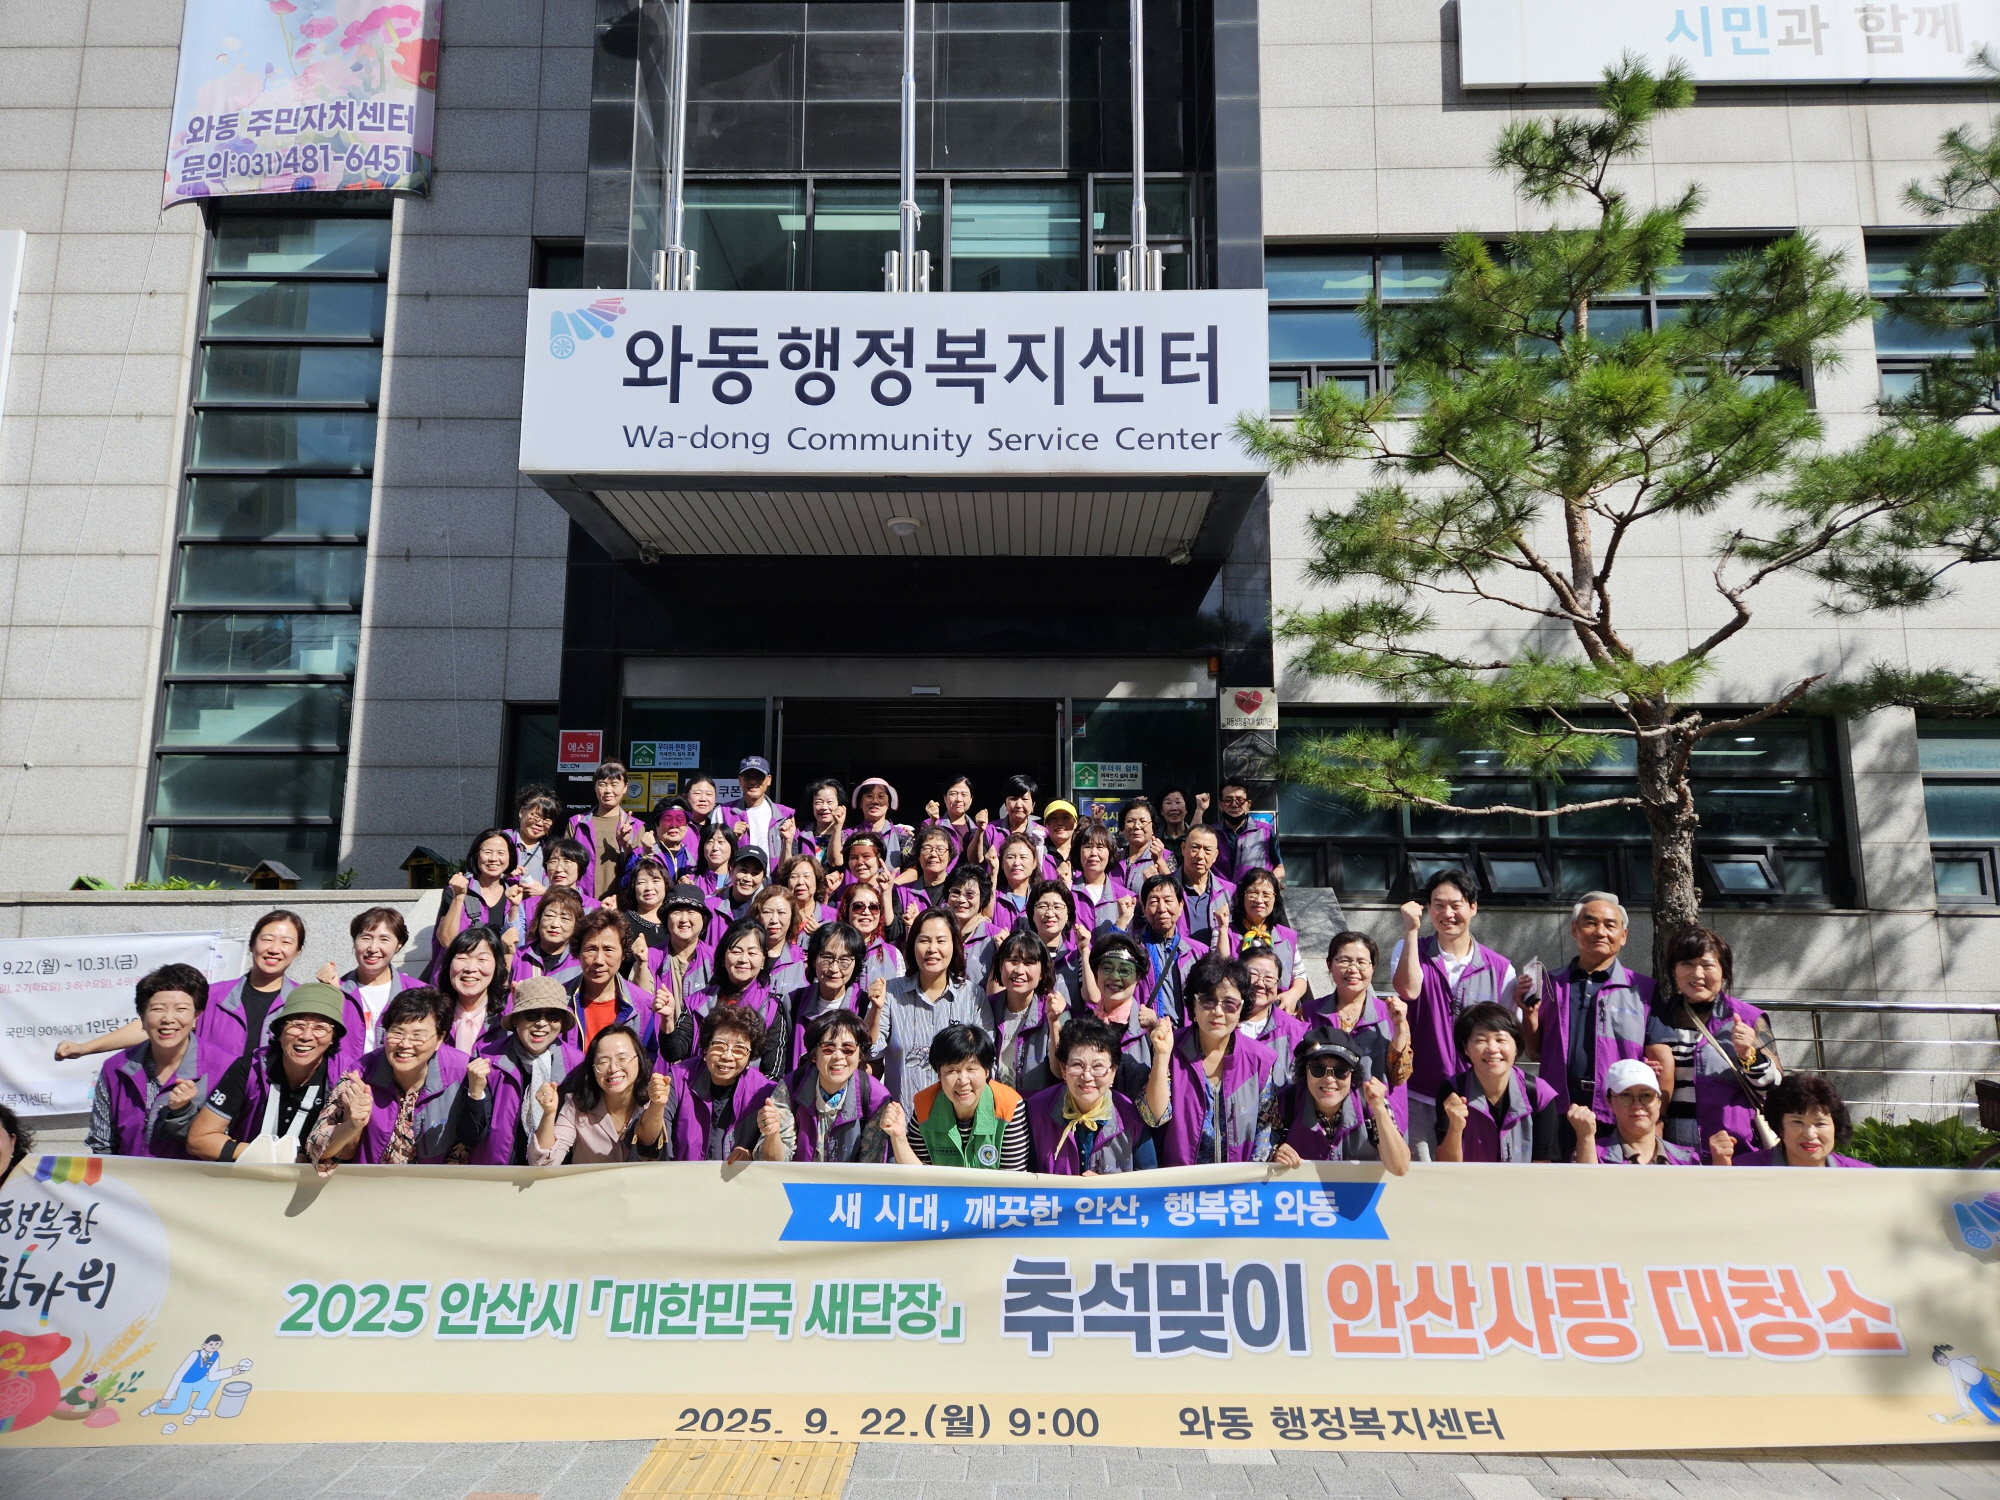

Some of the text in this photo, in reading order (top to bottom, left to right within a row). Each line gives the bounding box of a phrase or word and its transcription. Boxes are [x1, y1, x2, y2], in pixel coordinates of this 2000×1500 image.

[1665, 4, 1829, 57] 시민과
[186, 100, 415, 145] 와동 주민자치센터
[181, 144, 413, 183] 문의:031)481-6451
[622, 324, 1220, 406] 와동행정복지센터
[622, 424, 1222, 457] Wa-dong Community Service Center
[567, 742, 594, 753] 에스원
[718, 786, 741, 797] 쿠폰
[77, 954, 138, 972] 10.31.(금)
[5, 1026, 35, 1038] 국민의
[38, 1024, 83, 1036] 90%에게
[86, 1018, 120, 1034] 1인당
[829, 1189, 1340, 1233] 새 시대, 깨끗한 안산, 행복한 와동
[280, 1279, 964, 1339] 2025 안산시 「대한민국 새단장」
[1003, 1257, 1903, 1358] 추석맞이 안산사랑 대청소
[675, 1404, 1506, 1442] 2025. 9. 22.(월) 9:00 와동 행정복지센터
